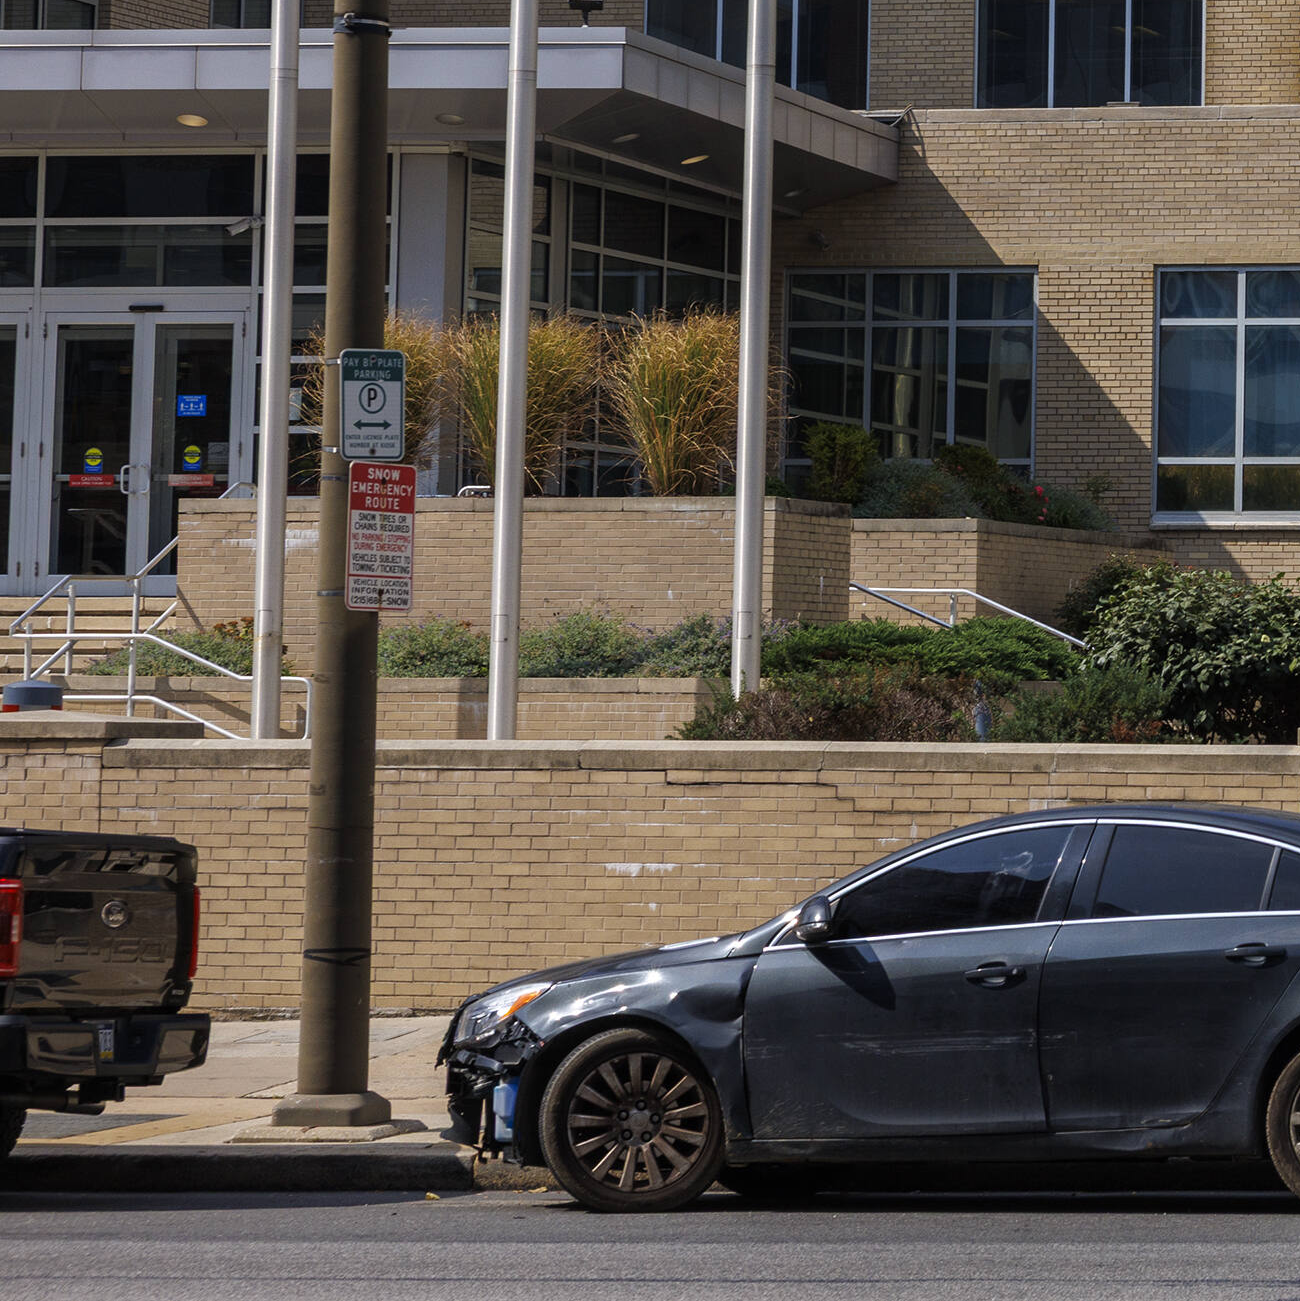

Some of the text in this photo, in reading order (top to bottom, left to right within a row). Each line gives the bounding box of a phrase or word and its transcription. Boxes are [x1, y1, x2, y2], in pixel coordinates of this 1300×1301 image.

[343, 357, 359, 367] PAY
[377, 359, 402, 369] PLATE
[353, 369, 391, 380] PARKING
[367, 387, 377, 408] P
[367, 467, 401, 481] SNOW
[352, 481, 414, 497] EMERGENCY
[365, 496, 400, 510] ROUTE
[358, 513, 377, 521] SNOW
[398, 515, 407, 524] OR
[354, 522, 410, 533] CHAINS REQUIRED
